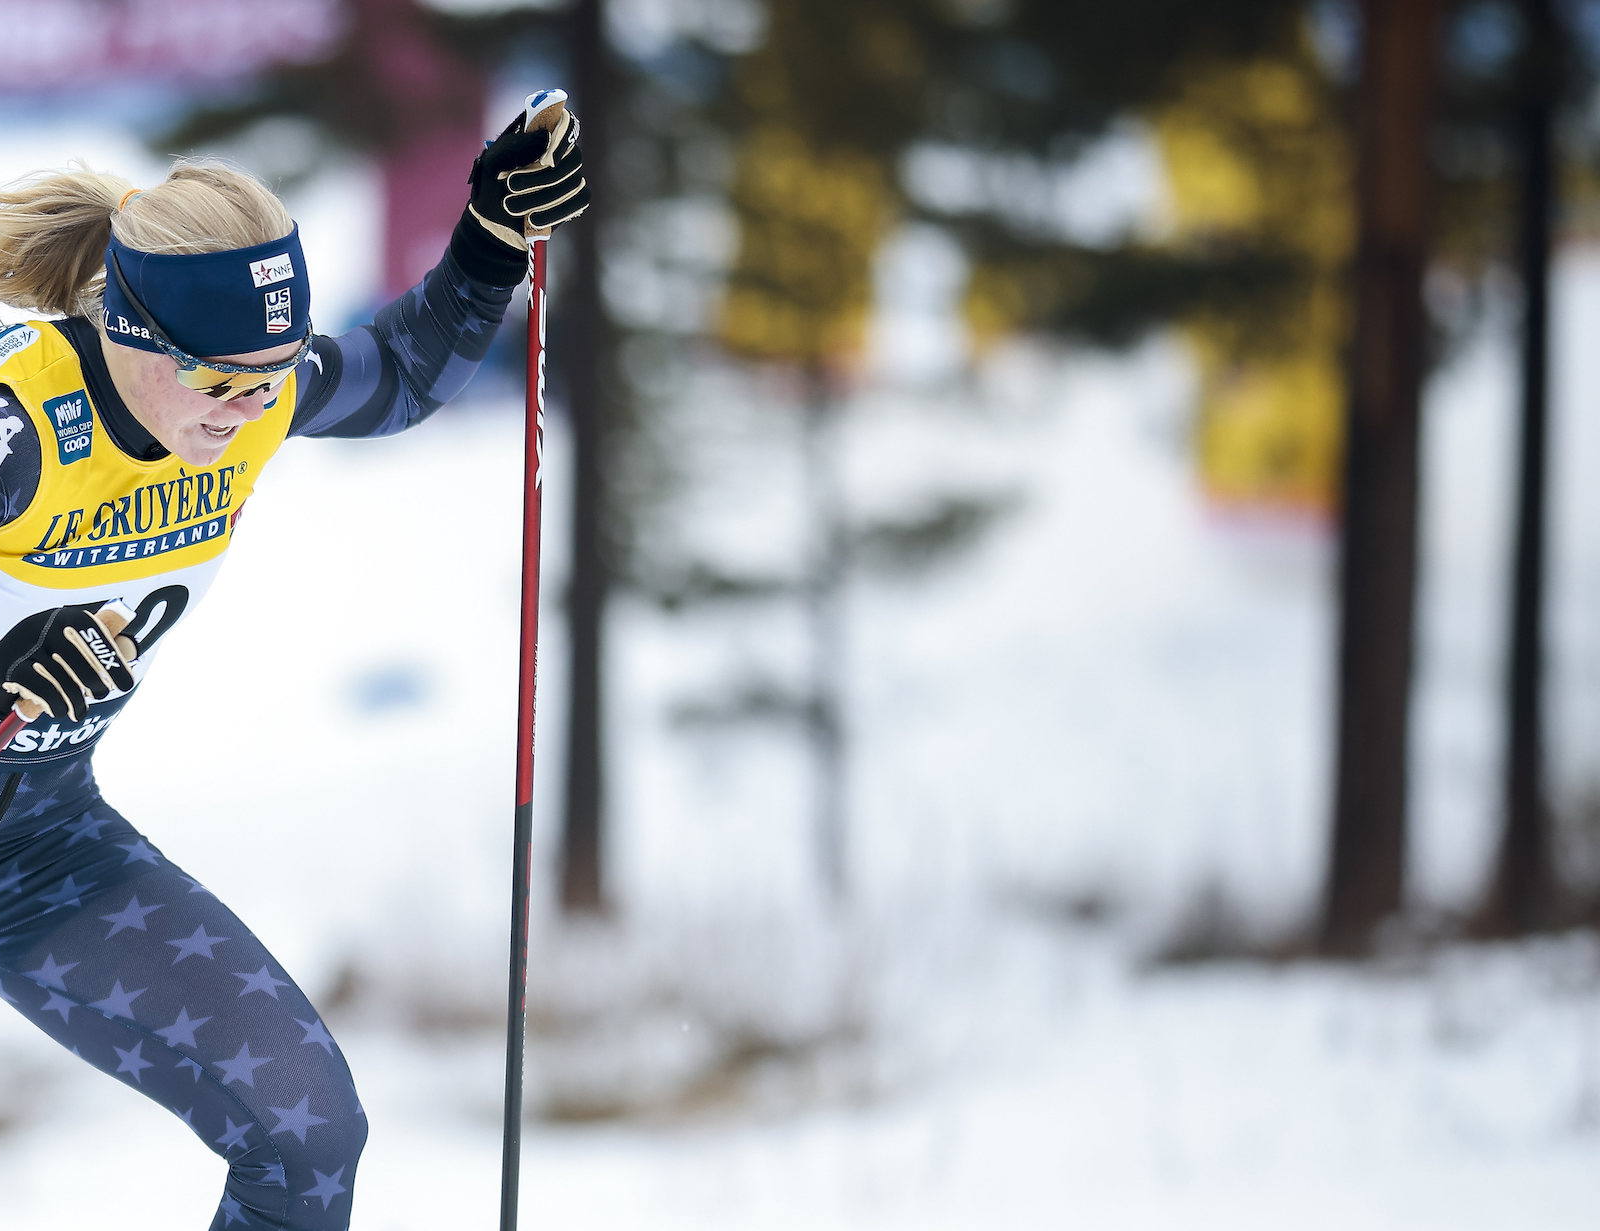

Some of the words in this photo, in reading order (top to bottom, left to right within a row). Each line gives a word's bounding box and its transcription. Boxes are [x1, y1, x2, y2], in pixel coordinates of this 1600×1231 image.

[274, 263, 292, 277] NNF
[267, 289, 289, 306] US
[57, 425, 78, 438] WORLD
[79, 421, 92, 433] CUP
[33, 508, 84, 551] LE
[87, 466, 235, 542] GRUYÈRE
[32, 520, 220, 566] SWITZERLAND
